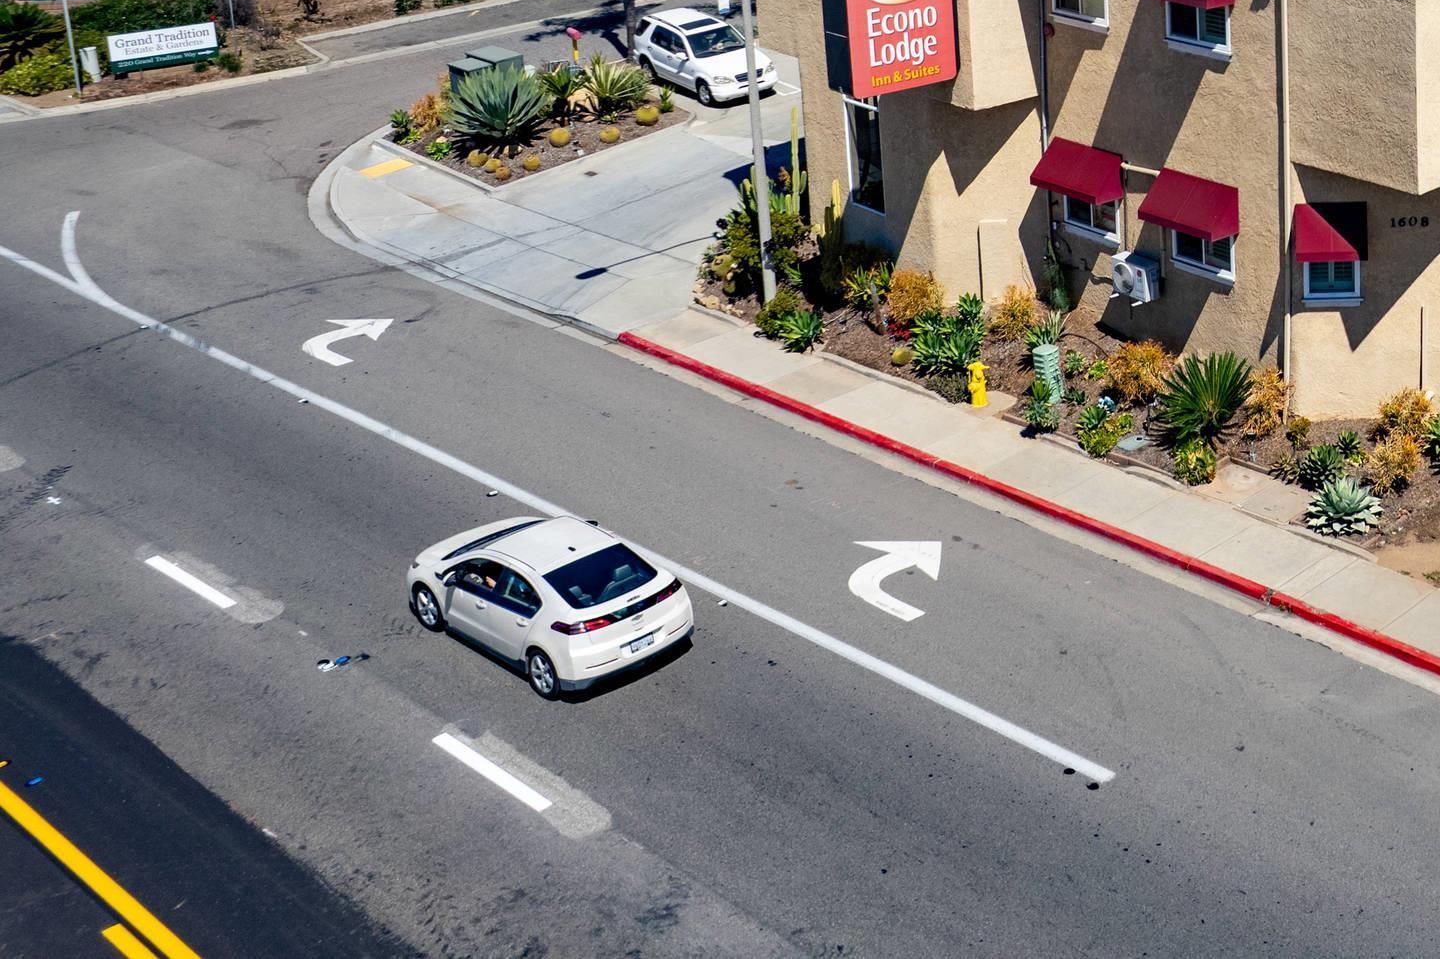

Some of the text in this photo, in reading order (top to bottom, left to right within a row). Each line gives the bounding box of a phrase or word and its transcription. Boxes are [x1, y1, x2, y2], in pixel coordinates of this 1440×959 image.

[866, 6, 938, 38] Econo
[114, 28, 210, 49] Grand Tradition
[125, 40, 203, 56] Estate & Gardens
[156, 54, 182, 62] Tradition
[869, 32, 938, 67] Lodge
[871, 65, 940, 88] Inn & Suites
[1390, 216, 1430, 228] 1608
